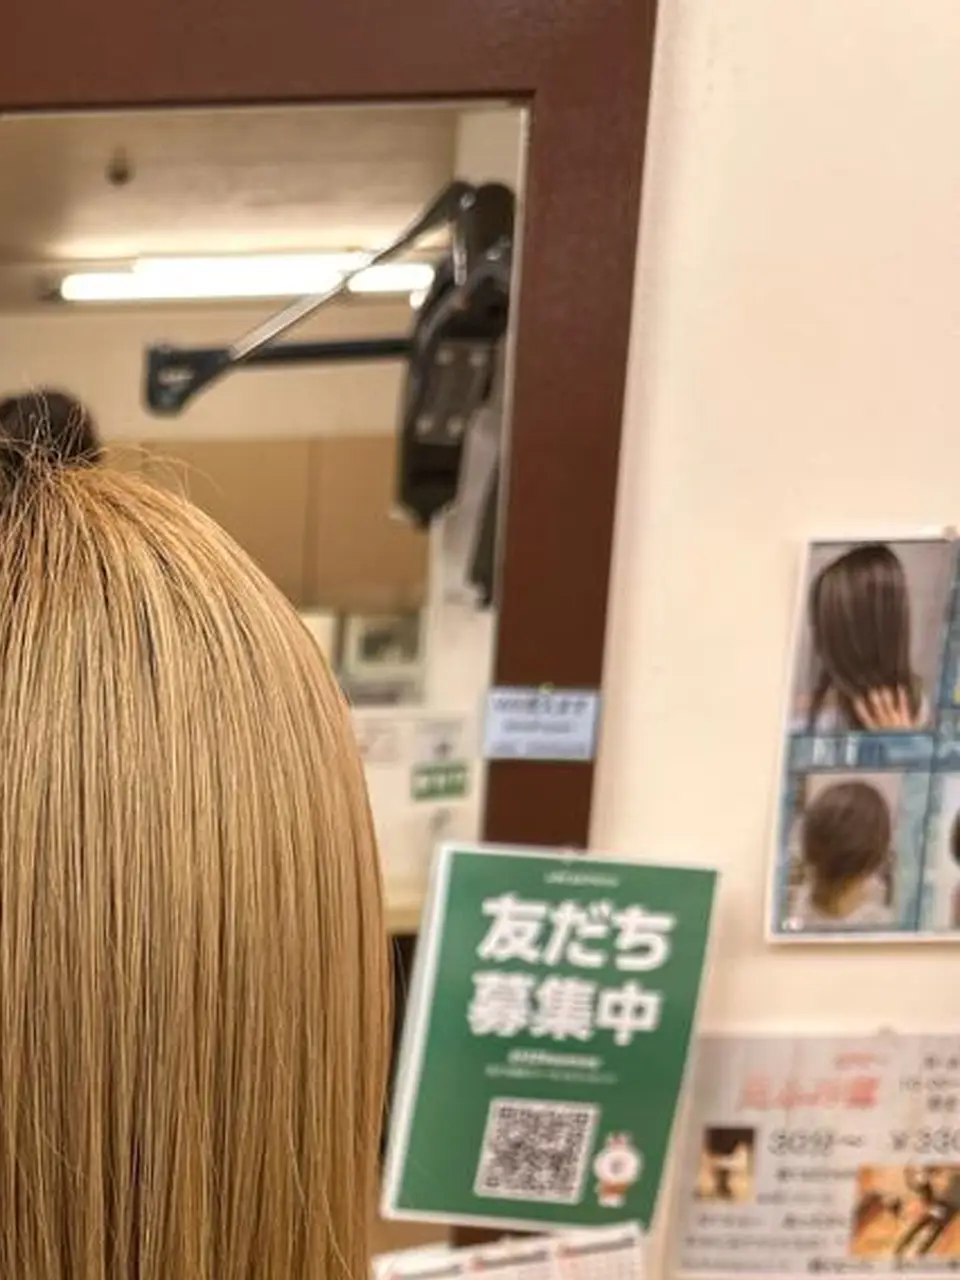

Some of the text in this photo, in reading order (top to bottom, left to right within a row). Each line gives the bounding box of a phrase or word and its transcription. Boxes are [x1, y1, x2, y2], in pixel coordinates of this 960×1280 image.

[476, 893, 677, 972] 友だち
[466, 971, 662, 1046] 募集中
